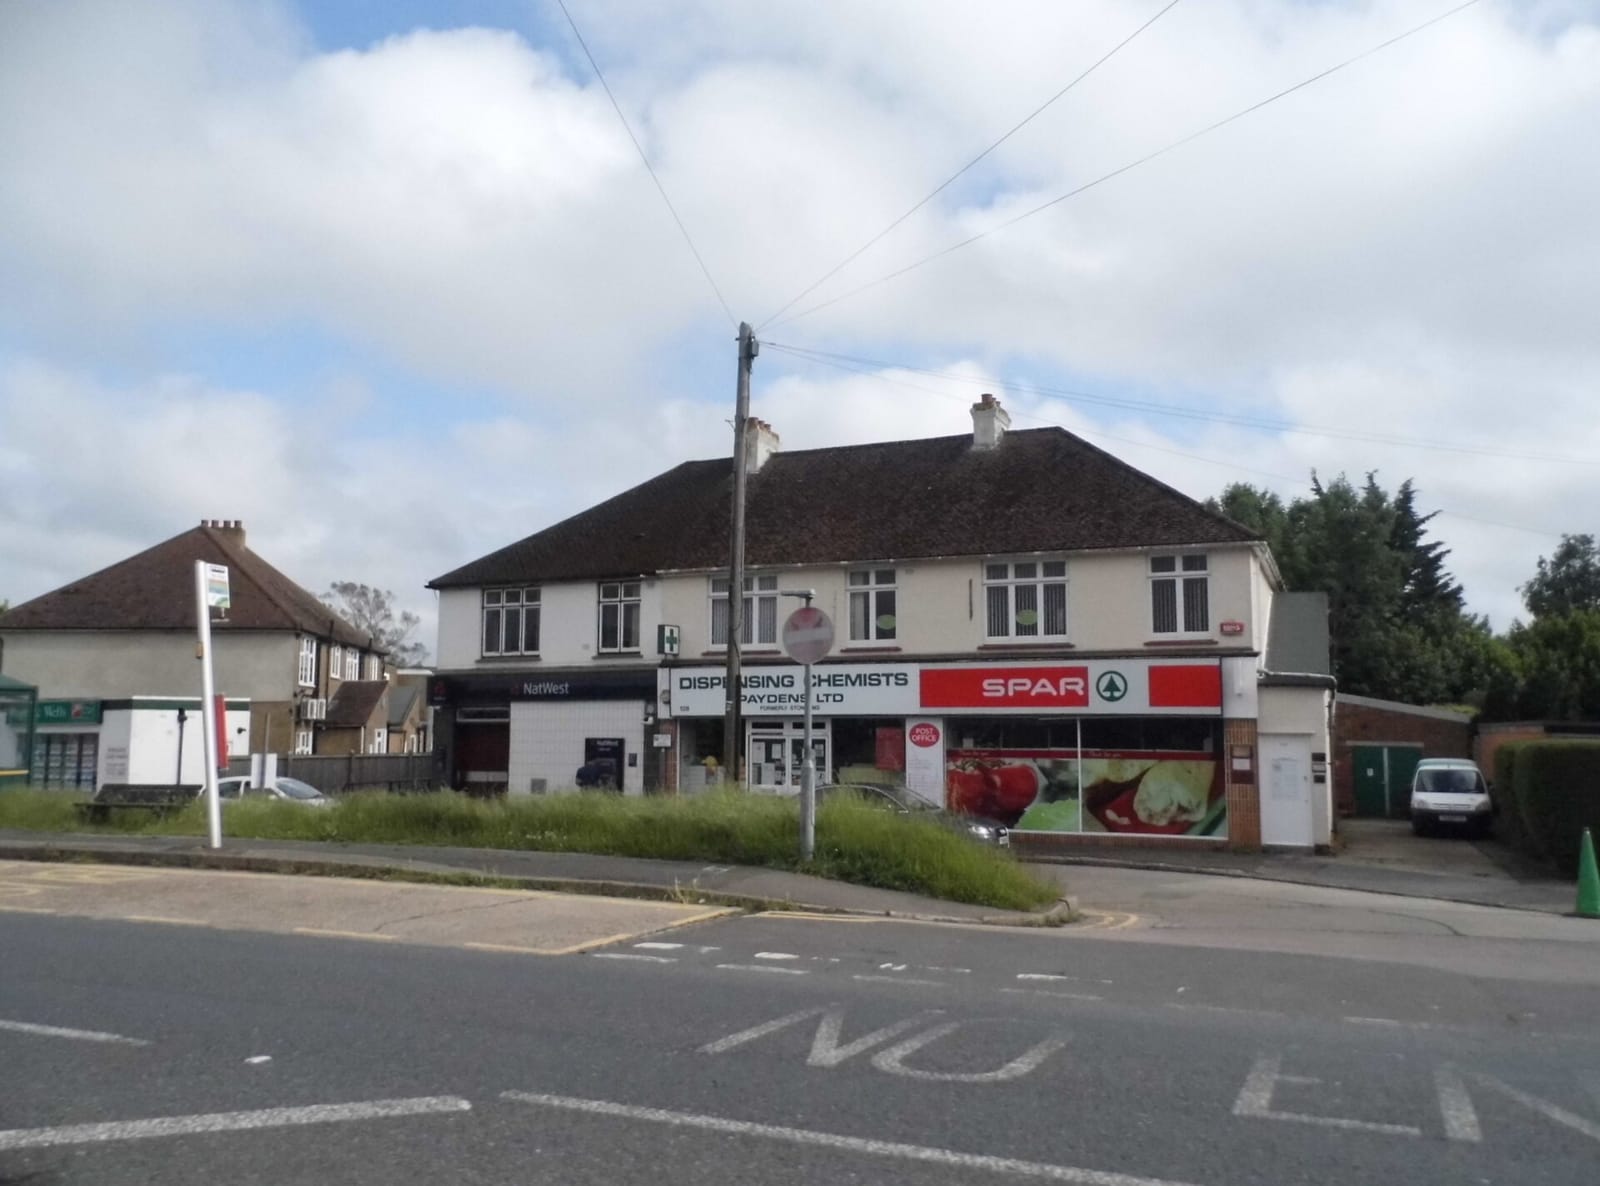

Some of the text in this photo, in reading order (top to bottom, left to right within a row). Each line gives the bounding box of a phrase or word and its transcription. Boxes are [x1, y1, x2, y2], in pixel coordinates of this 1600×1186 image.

[523, 682, 569, 695] NatWest
[982, 677, 1085, 697] SPAR
[816, 693, 844, 703] LTD
[915, 727, 933, 735] POST
[911, 734, 937, 742] OFFICE
[696, 1001, 1073, 1083] NO
